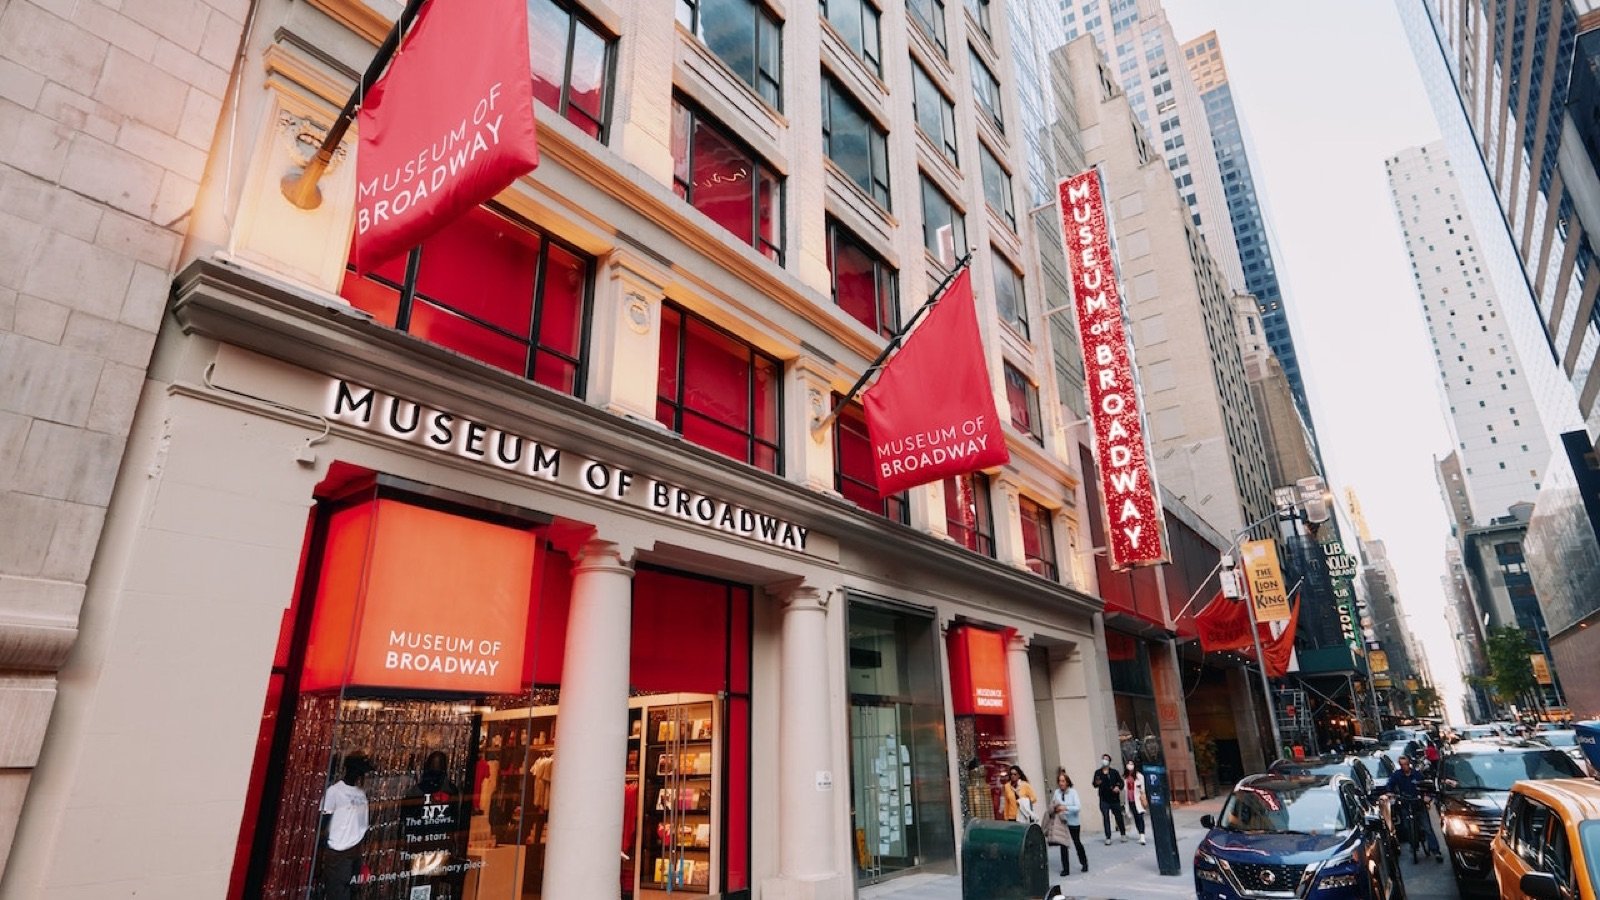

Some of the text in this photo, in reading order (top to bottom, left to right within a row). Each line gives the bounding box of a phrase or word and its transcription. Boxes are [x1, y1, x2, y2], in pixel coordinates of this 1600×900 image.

[358, 82, 503, 203] MUSEUM OF
[358, 114, 504, 236] BROADWAY
[1068, 181, 1108, 315] MUSEUM
[1095, 344, 1142, 550] BROADWAY
[876, 415, 986, 459] MUSEUM OF
[333, 379, 809, 551] MUSEUM OF BROADWAY
[880, 434, 988, 478] BROADWAY
[1255, 567, 1273, 577] THE
[1254, 580, 1279, 594] LION
[1254, 594, 1285, 610] KING
[389, 630, 502, 656] MUSEUM OF
[385, 651, 499, 676] BROADWAY
[1150, 774, 1157, 785] P
[405, 817, 422, 826] The
[421, 805, 449, 819] NY
[406, 832, 450, 843] The stars.
